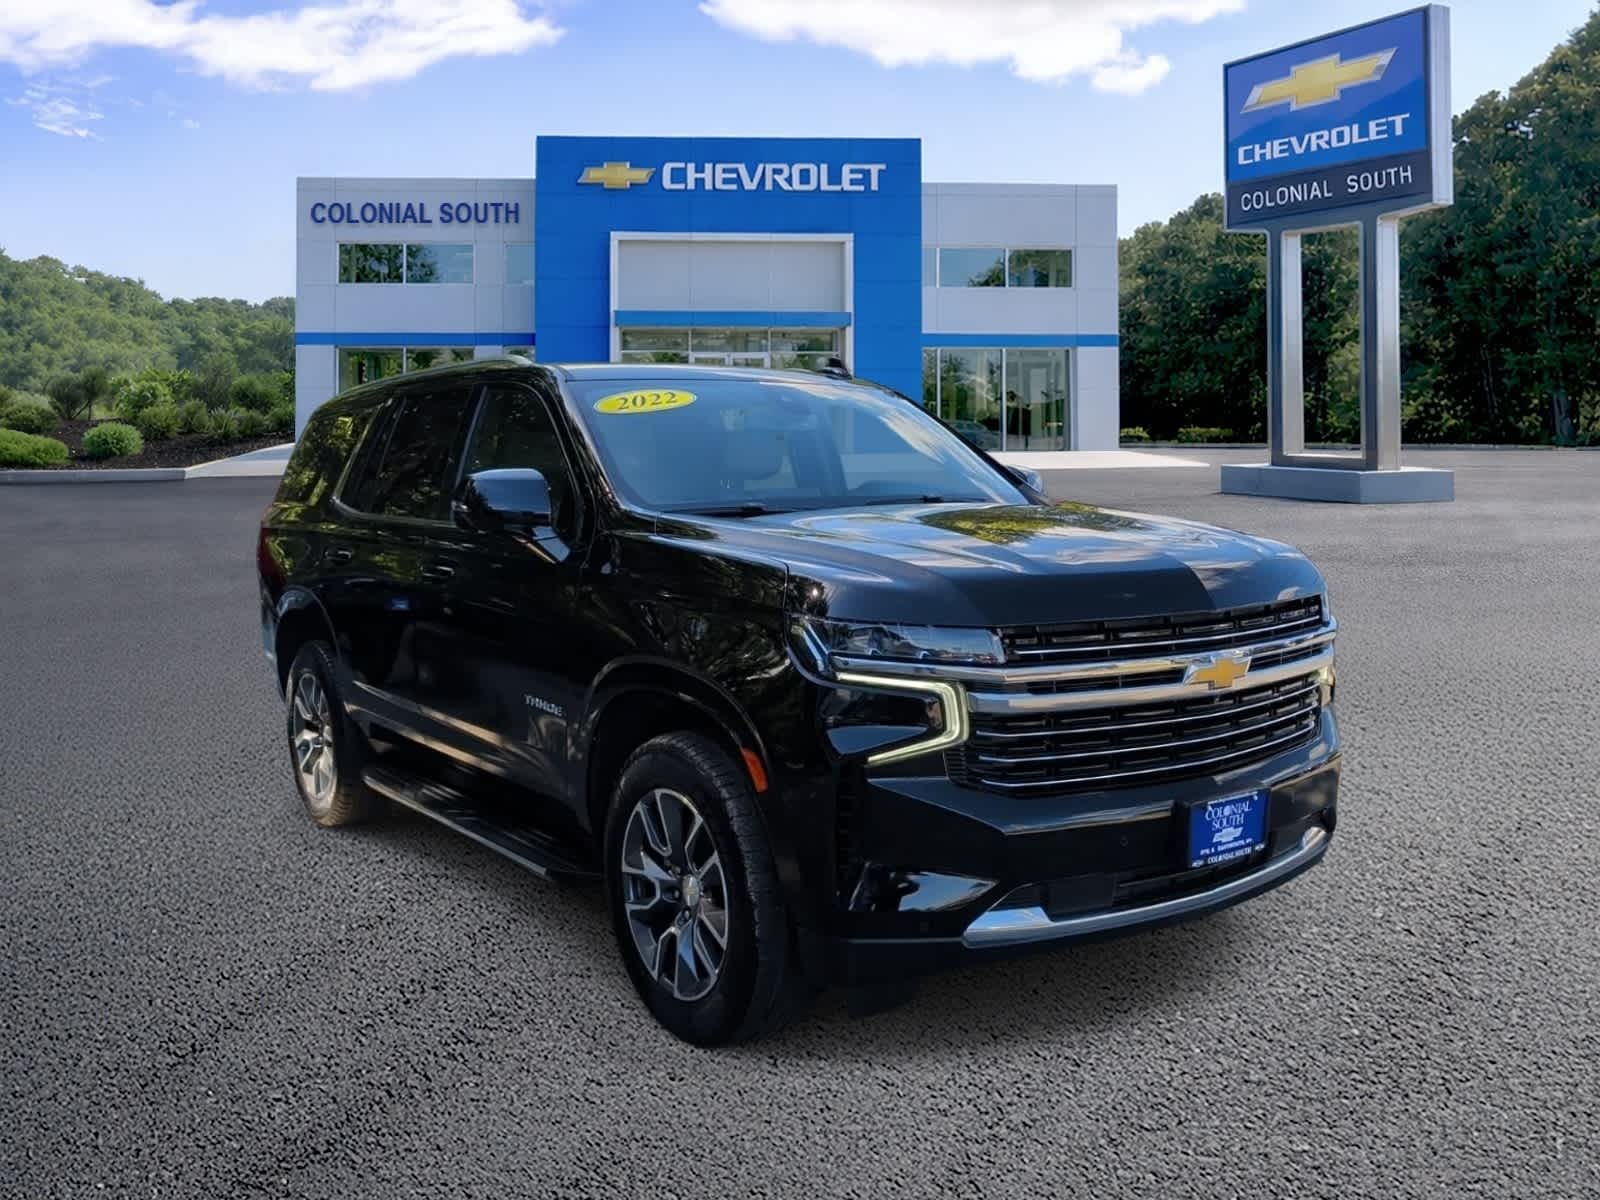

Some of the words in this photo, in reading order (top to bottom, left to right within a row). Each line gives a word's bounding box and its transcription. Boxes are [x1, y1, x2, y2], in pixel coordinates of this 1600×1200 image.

[1238, 113, 1410, 165] CHEVROLET
[661, 162, 886, 192] CHEVROLET
[1241, 180, 1333, 211] COLONIAL
[1347, 165, 1413, 193] SOUTH
[311, 202, 433, 224] COLONIAL
[440, 202, 520, 224] SOUTH
[615, 391, 678, 410] 2022
[1212, 813, 1244, 831] SOUTH
